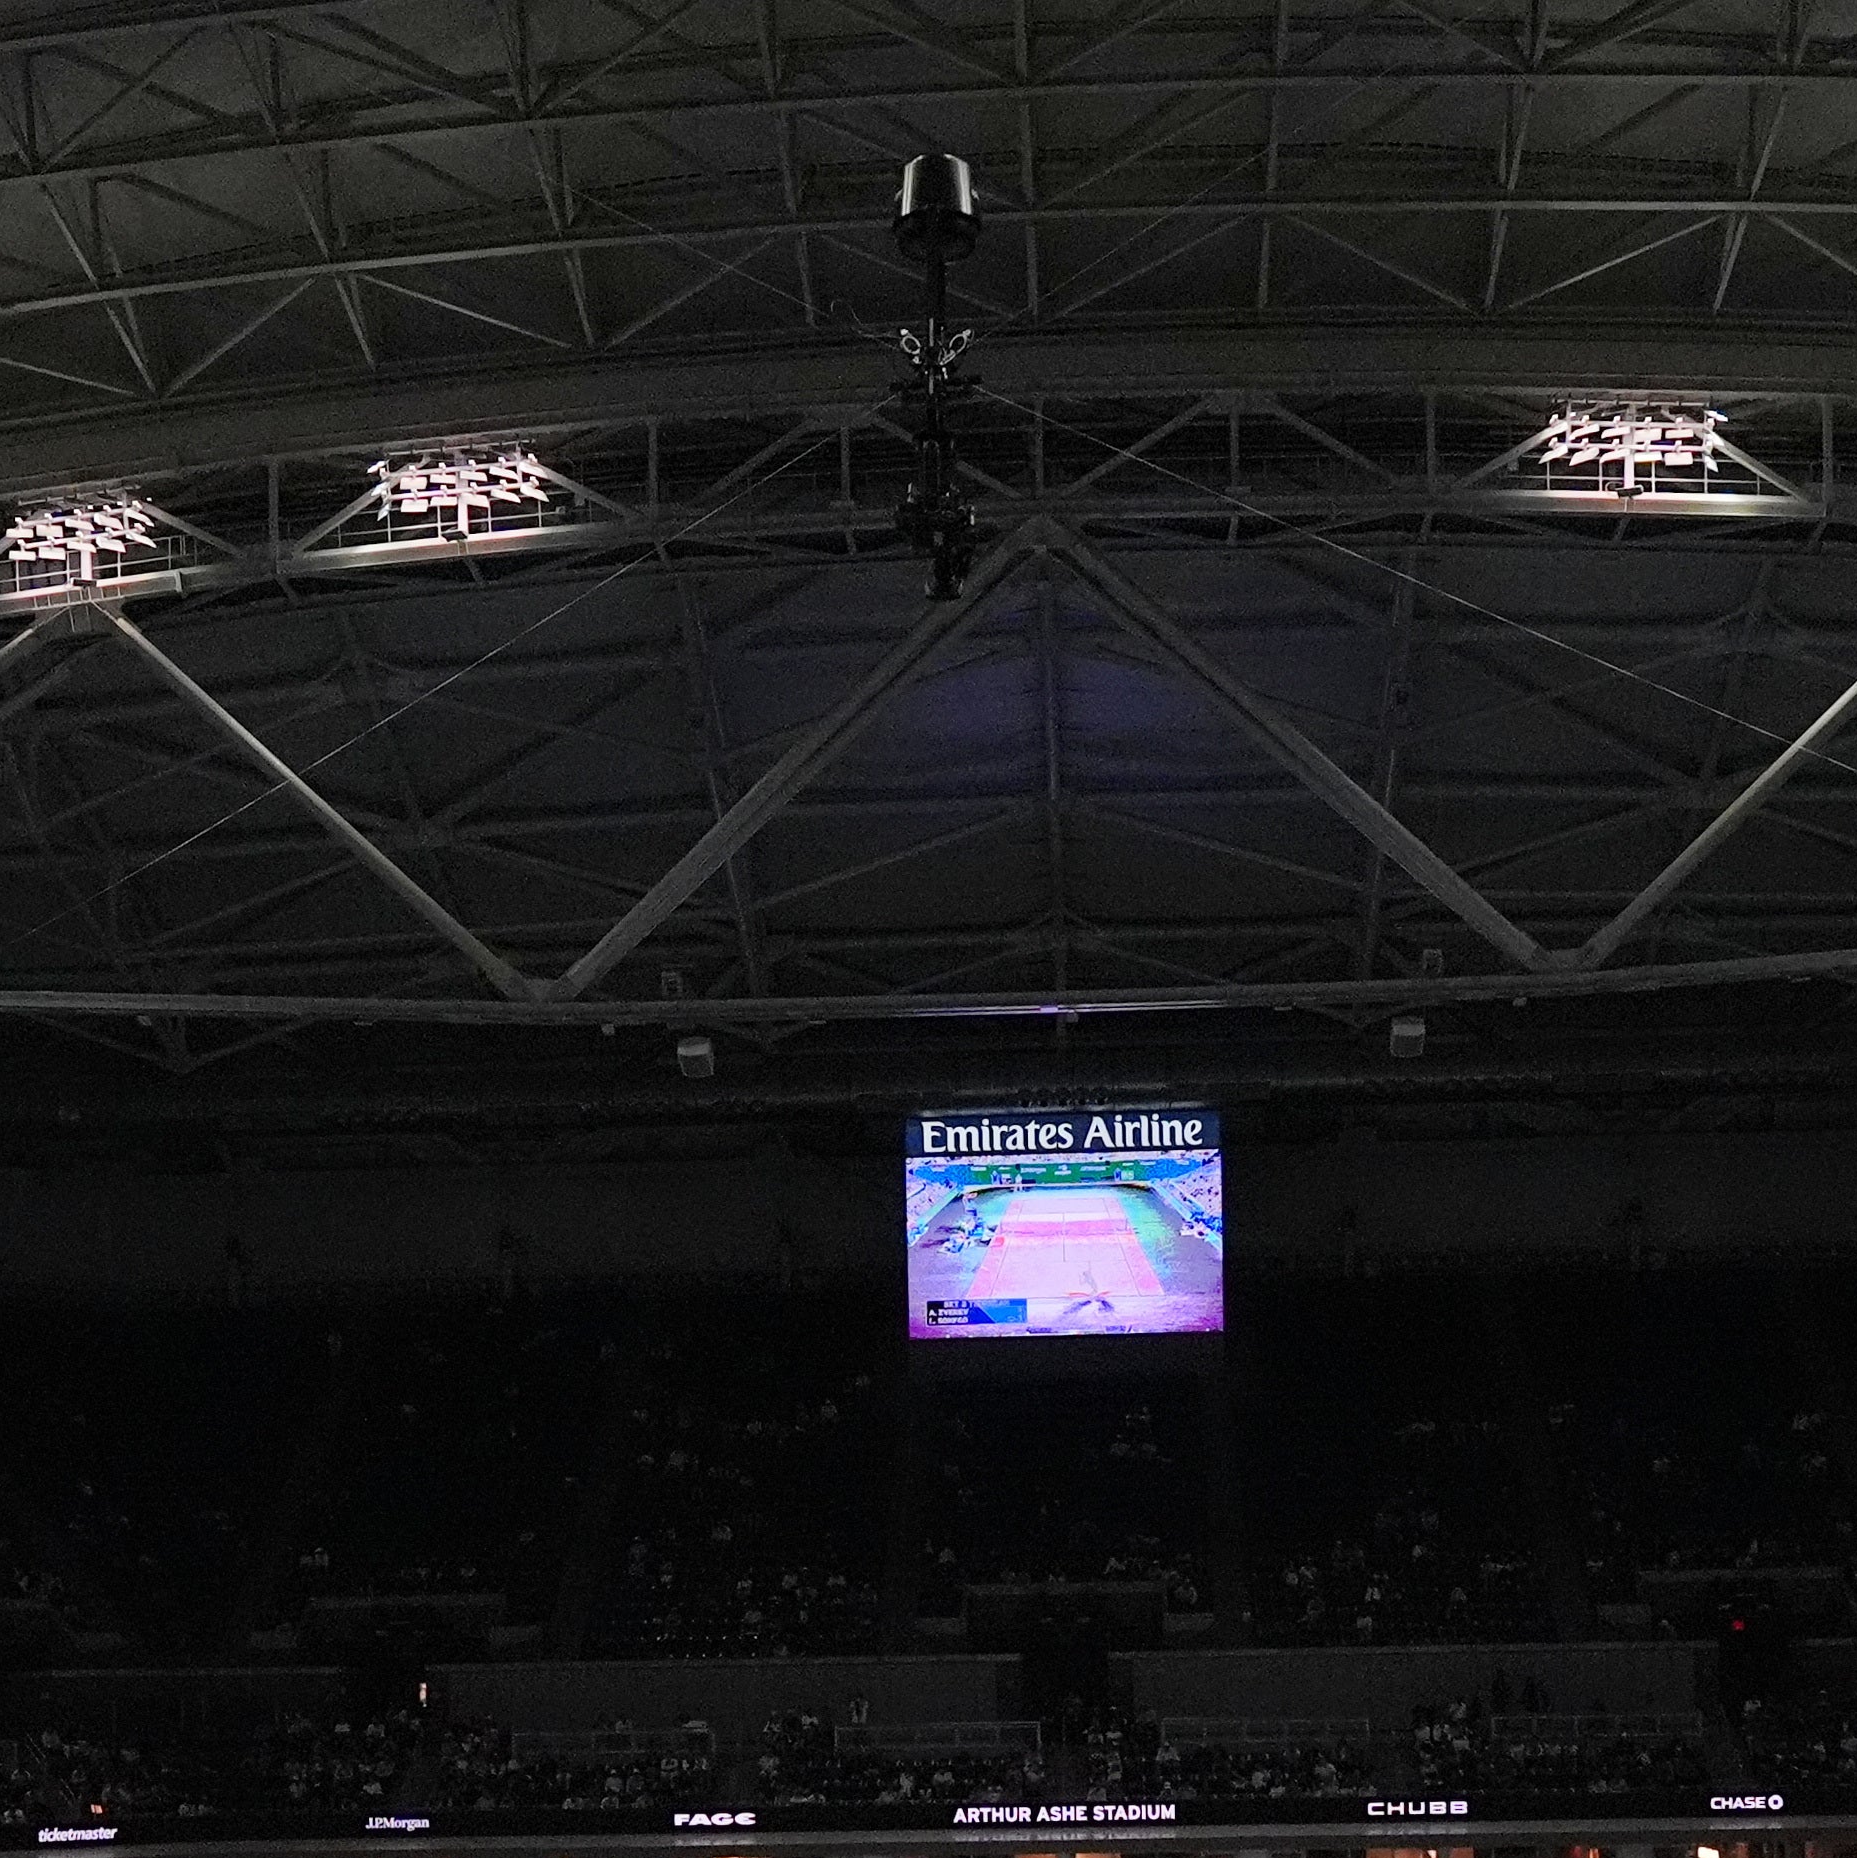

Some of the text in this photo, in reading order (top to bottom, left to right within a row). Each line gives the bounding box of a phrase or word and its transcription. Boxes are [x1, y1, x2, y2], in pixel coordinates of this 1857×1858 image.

[921, 1113, 1204, 1153] Emirates Airline
[1367, 1801, 1468, 1815] CHUBB
[1710, 1796, 1766, 1810] CHASE
[674, 1813, 756, 1826] FAGE
[953, 1804, 1176, 1824] ARTHUR ASHE STADIUM
[365, 1816, 430, 1832] J.P.Morgan
[38, 1826, 118, 1843] ticketmaster
